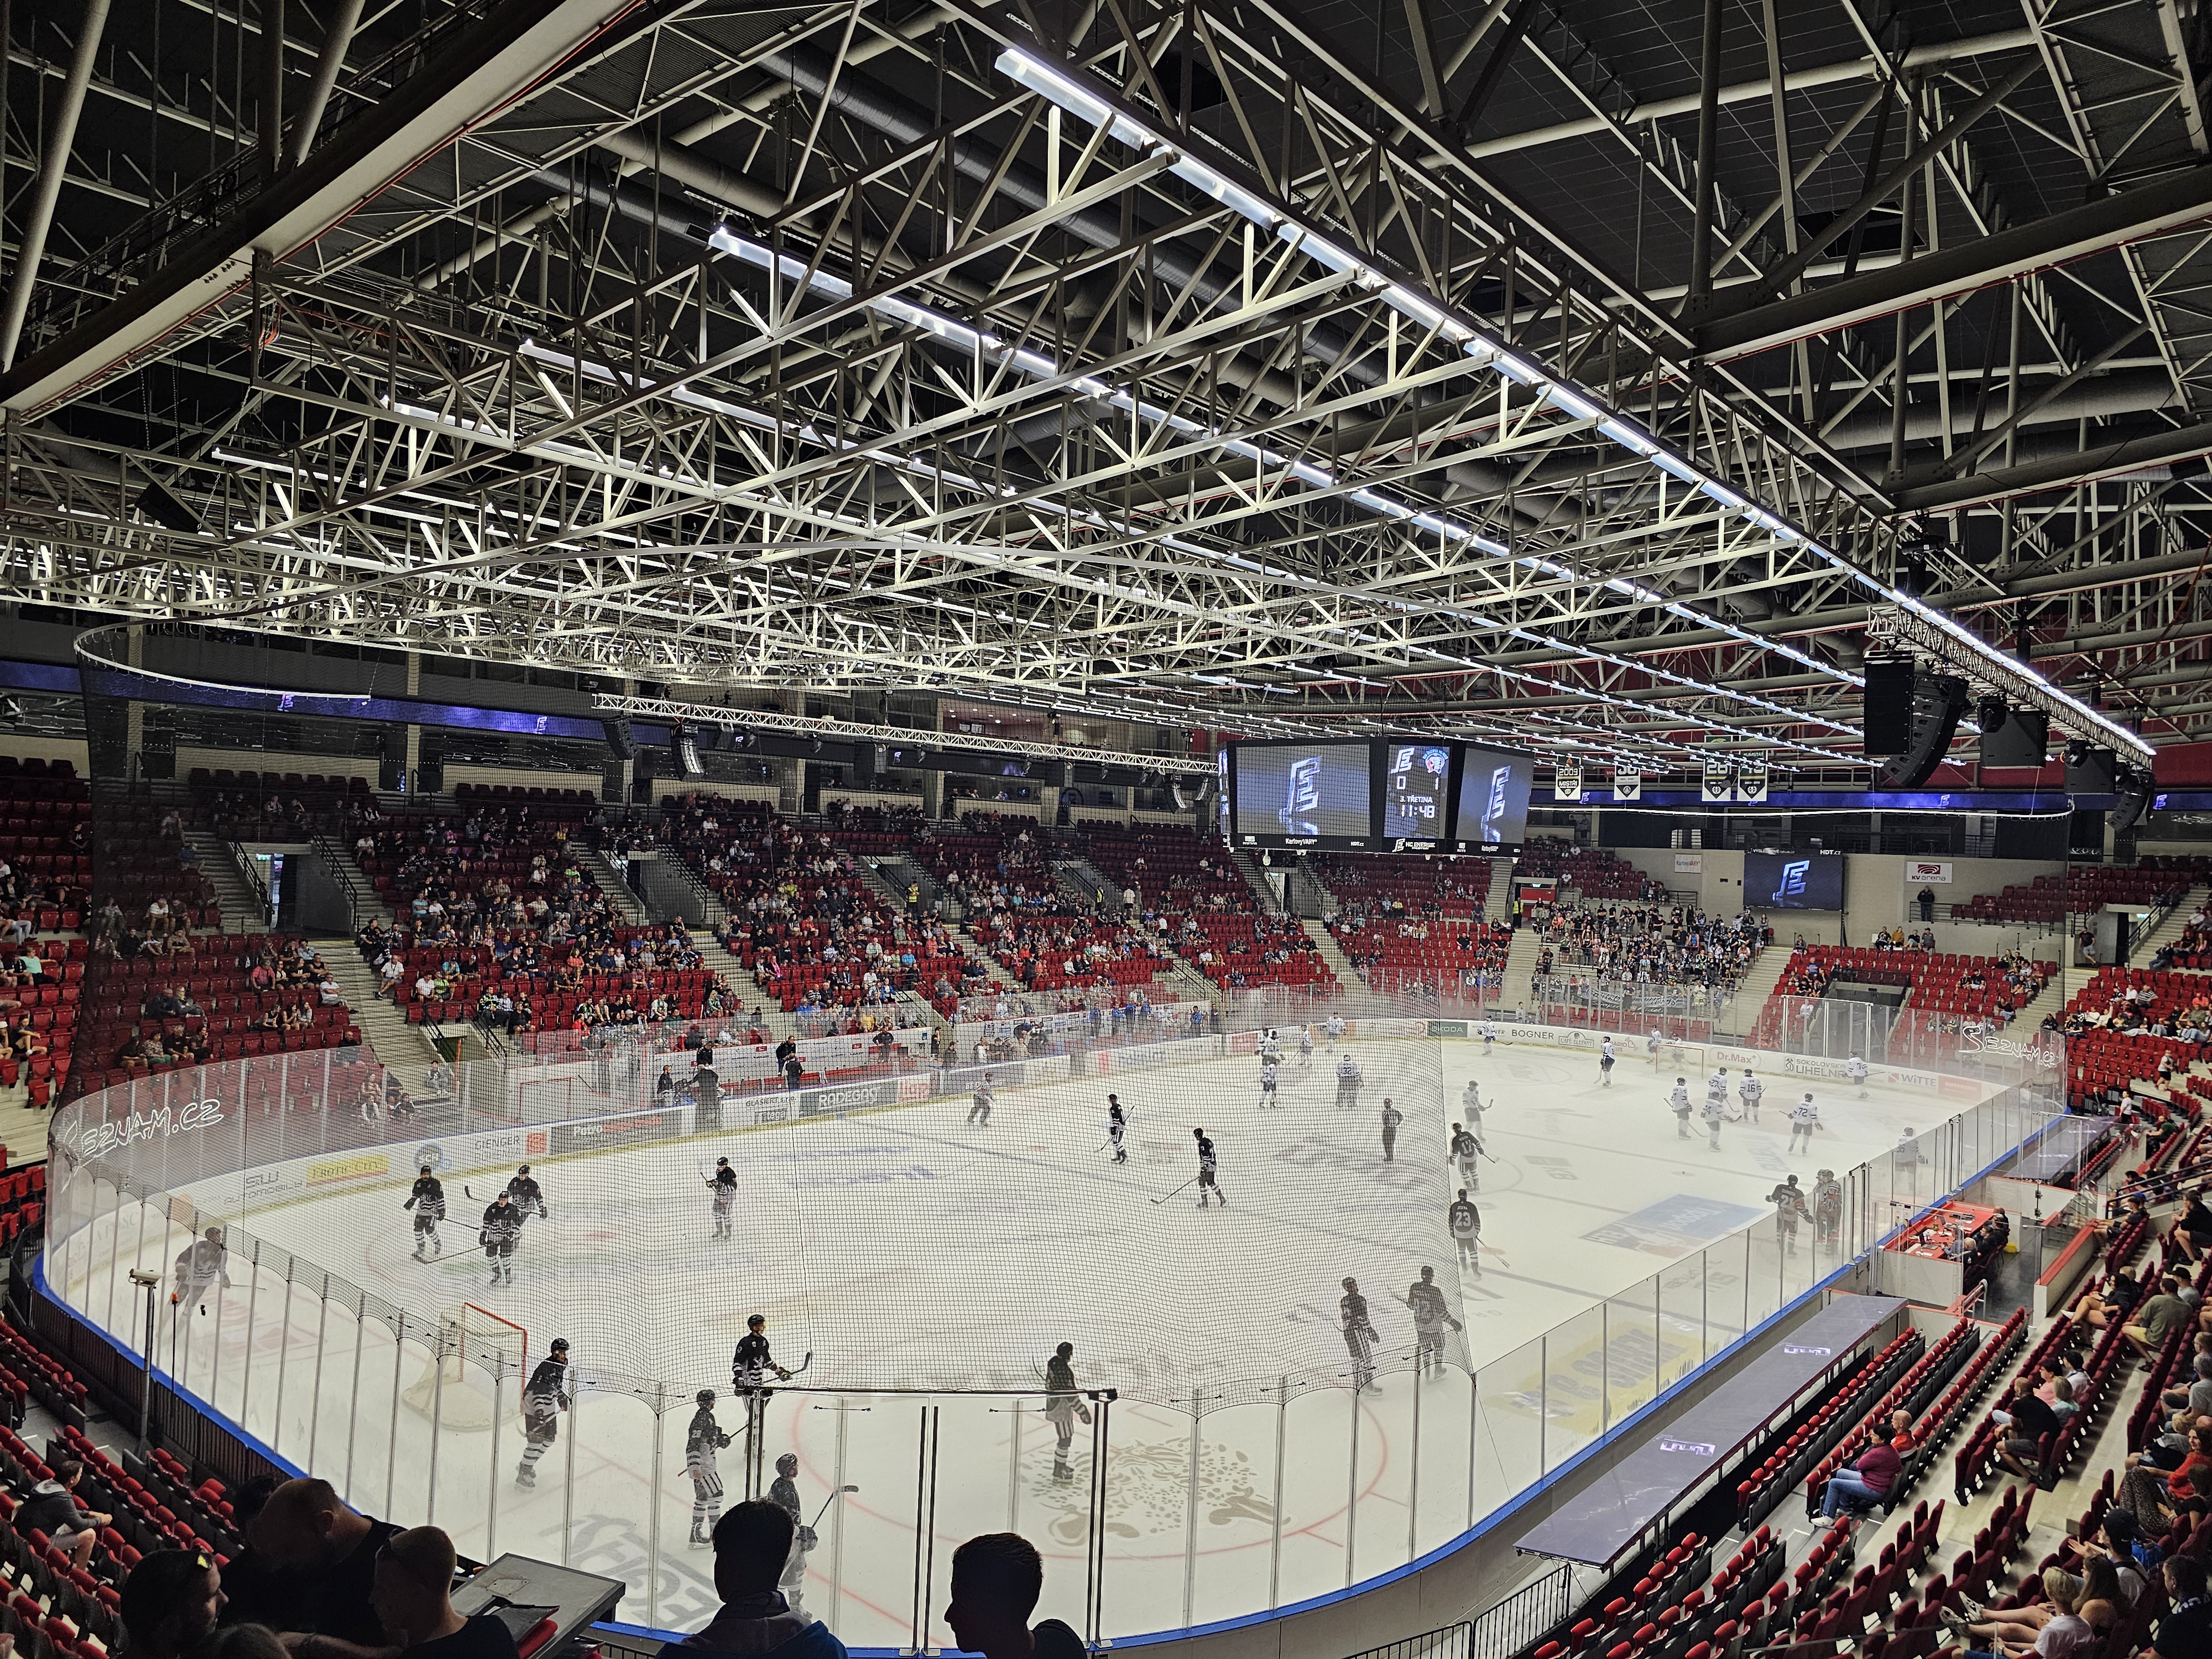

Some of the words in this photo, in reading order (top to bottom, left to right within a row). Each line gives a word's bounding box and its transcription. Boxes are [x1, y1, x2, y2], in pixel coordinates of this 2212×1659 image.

[1558, 768, 1578, 776] 2009
[1396, 776, 1406, 790] 0
[1434, 778, 1439, 790] 1
[1401, 805, 1435, 818] 11:48
[1511, 1029, 1554, 1040] BOGNER
[1573, 1039, 1593, 1047] ELEFANT
[1958, 1026, 2056, 1068] SEZNAM.CZ
[1747, 1084, 1756, 1092] 16
[1798, 1107, 1808, 1117] 72
[1455, 1211, 1472, 1227] 23
